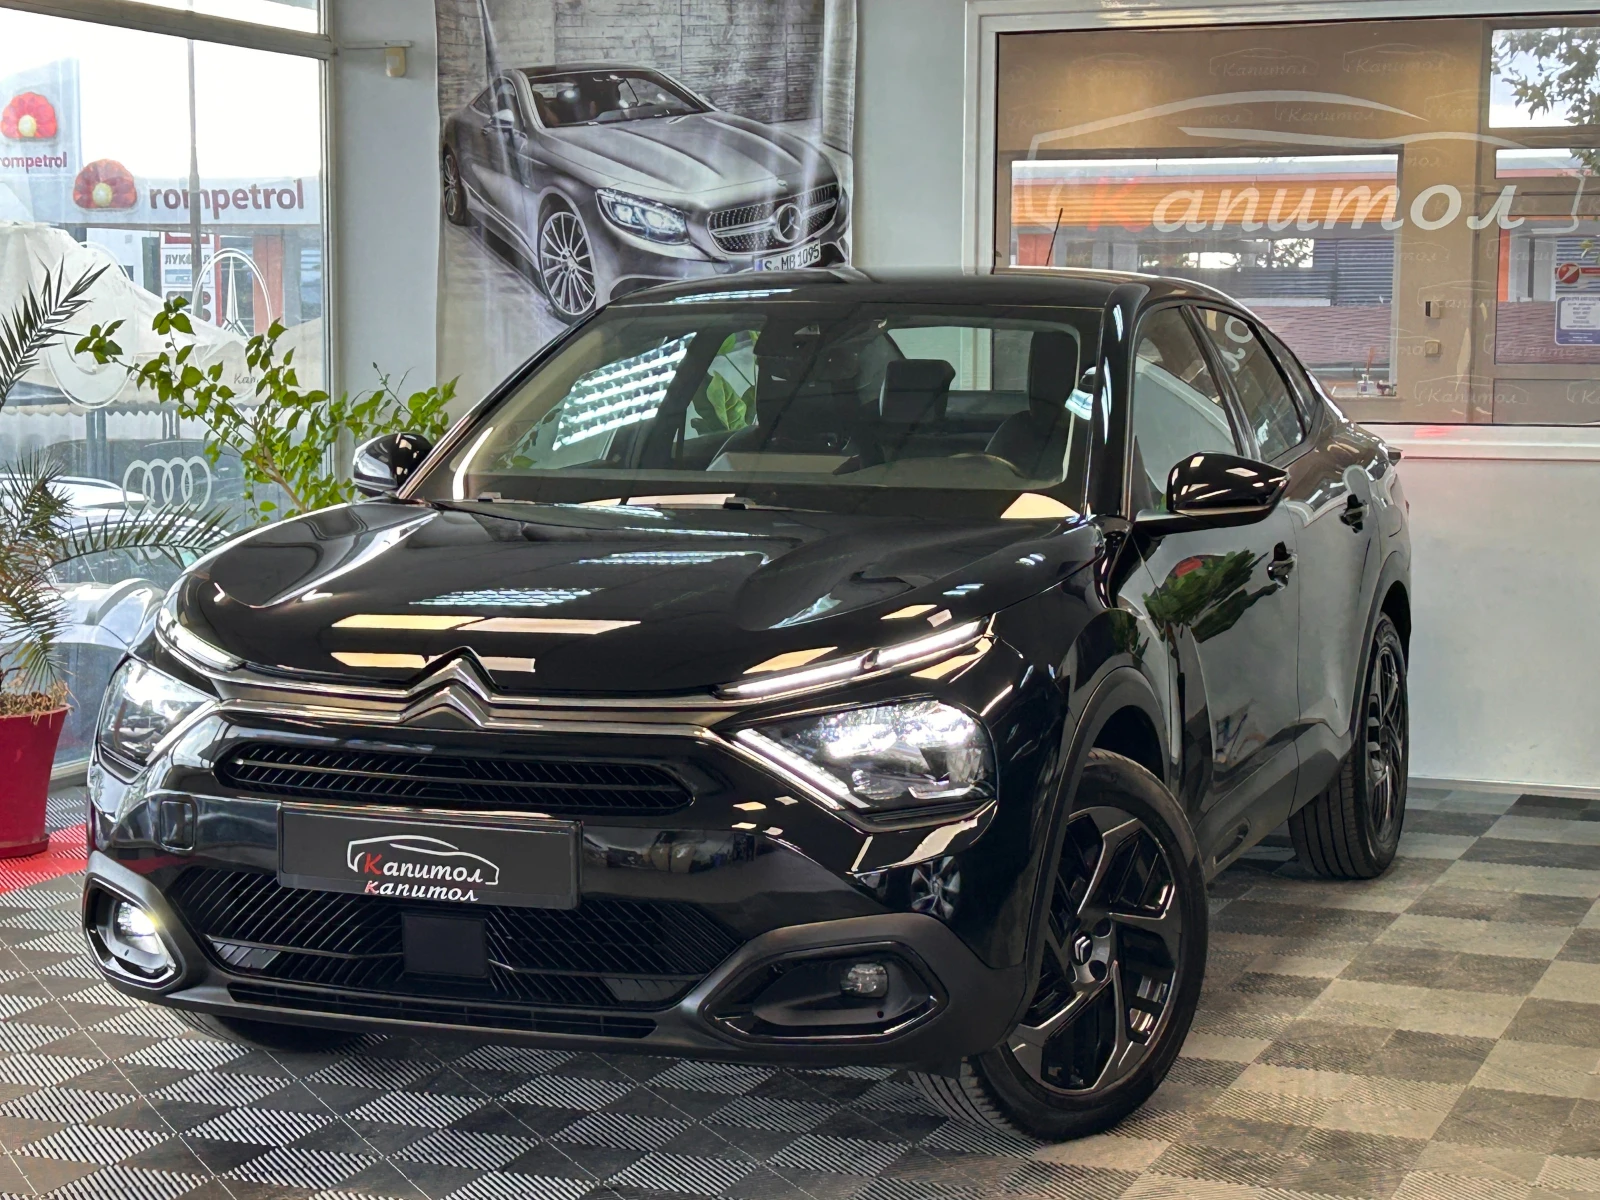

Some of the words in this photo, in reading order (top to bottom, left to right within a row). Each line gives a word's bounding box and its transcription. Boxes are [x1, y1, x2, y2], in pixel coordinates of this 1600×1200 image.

[0, 151, 67, 174] ompetrol
[149, 178, 304, 220] rompetrol
[1087, 174, 1526, 235] Капитол
[797, 243, 819, 266] 1095
[364, 853, 483, 882] Капитол
